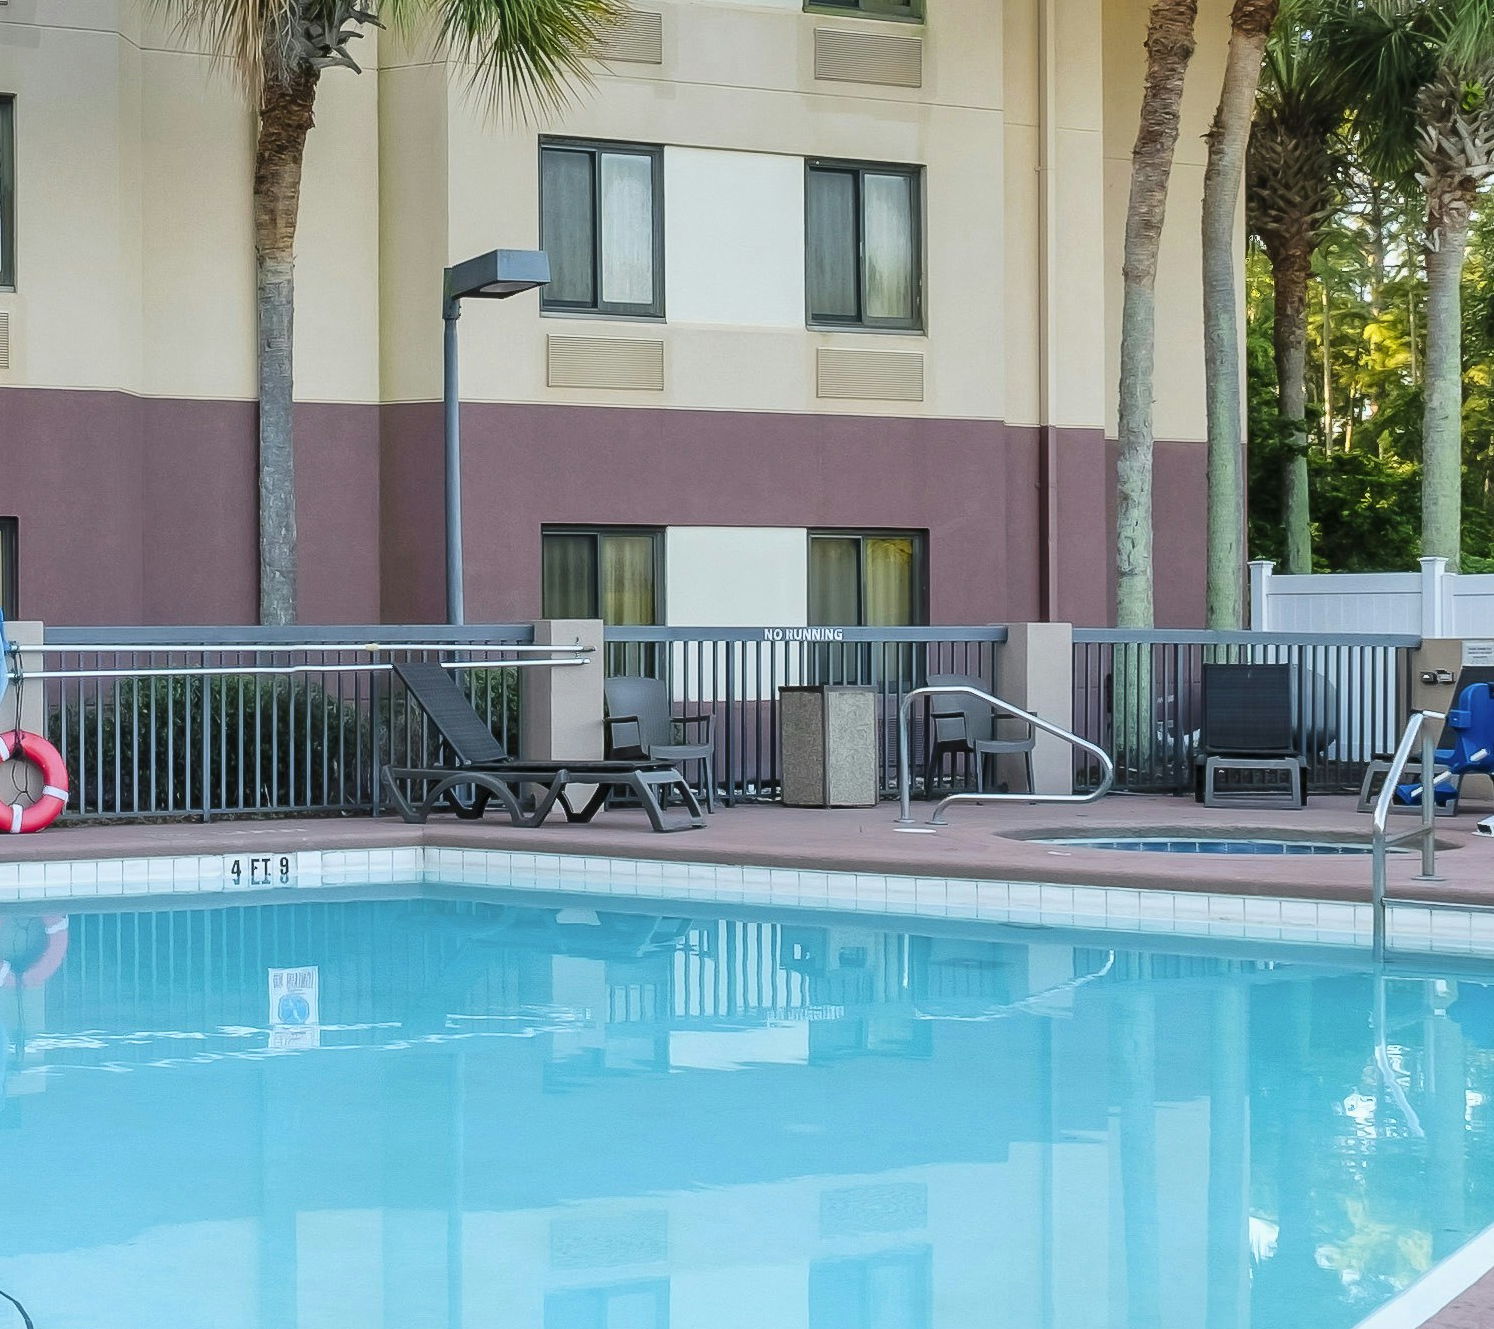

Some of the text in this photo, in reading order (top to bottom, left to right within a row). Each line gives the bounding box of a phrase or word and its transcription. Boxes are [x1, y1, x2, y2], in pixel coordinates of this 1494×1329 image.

[764, 628, 843, 641] NO RUNNING
[231, 859, 242, 879] 4
[279, 856, 289, 875] 9
